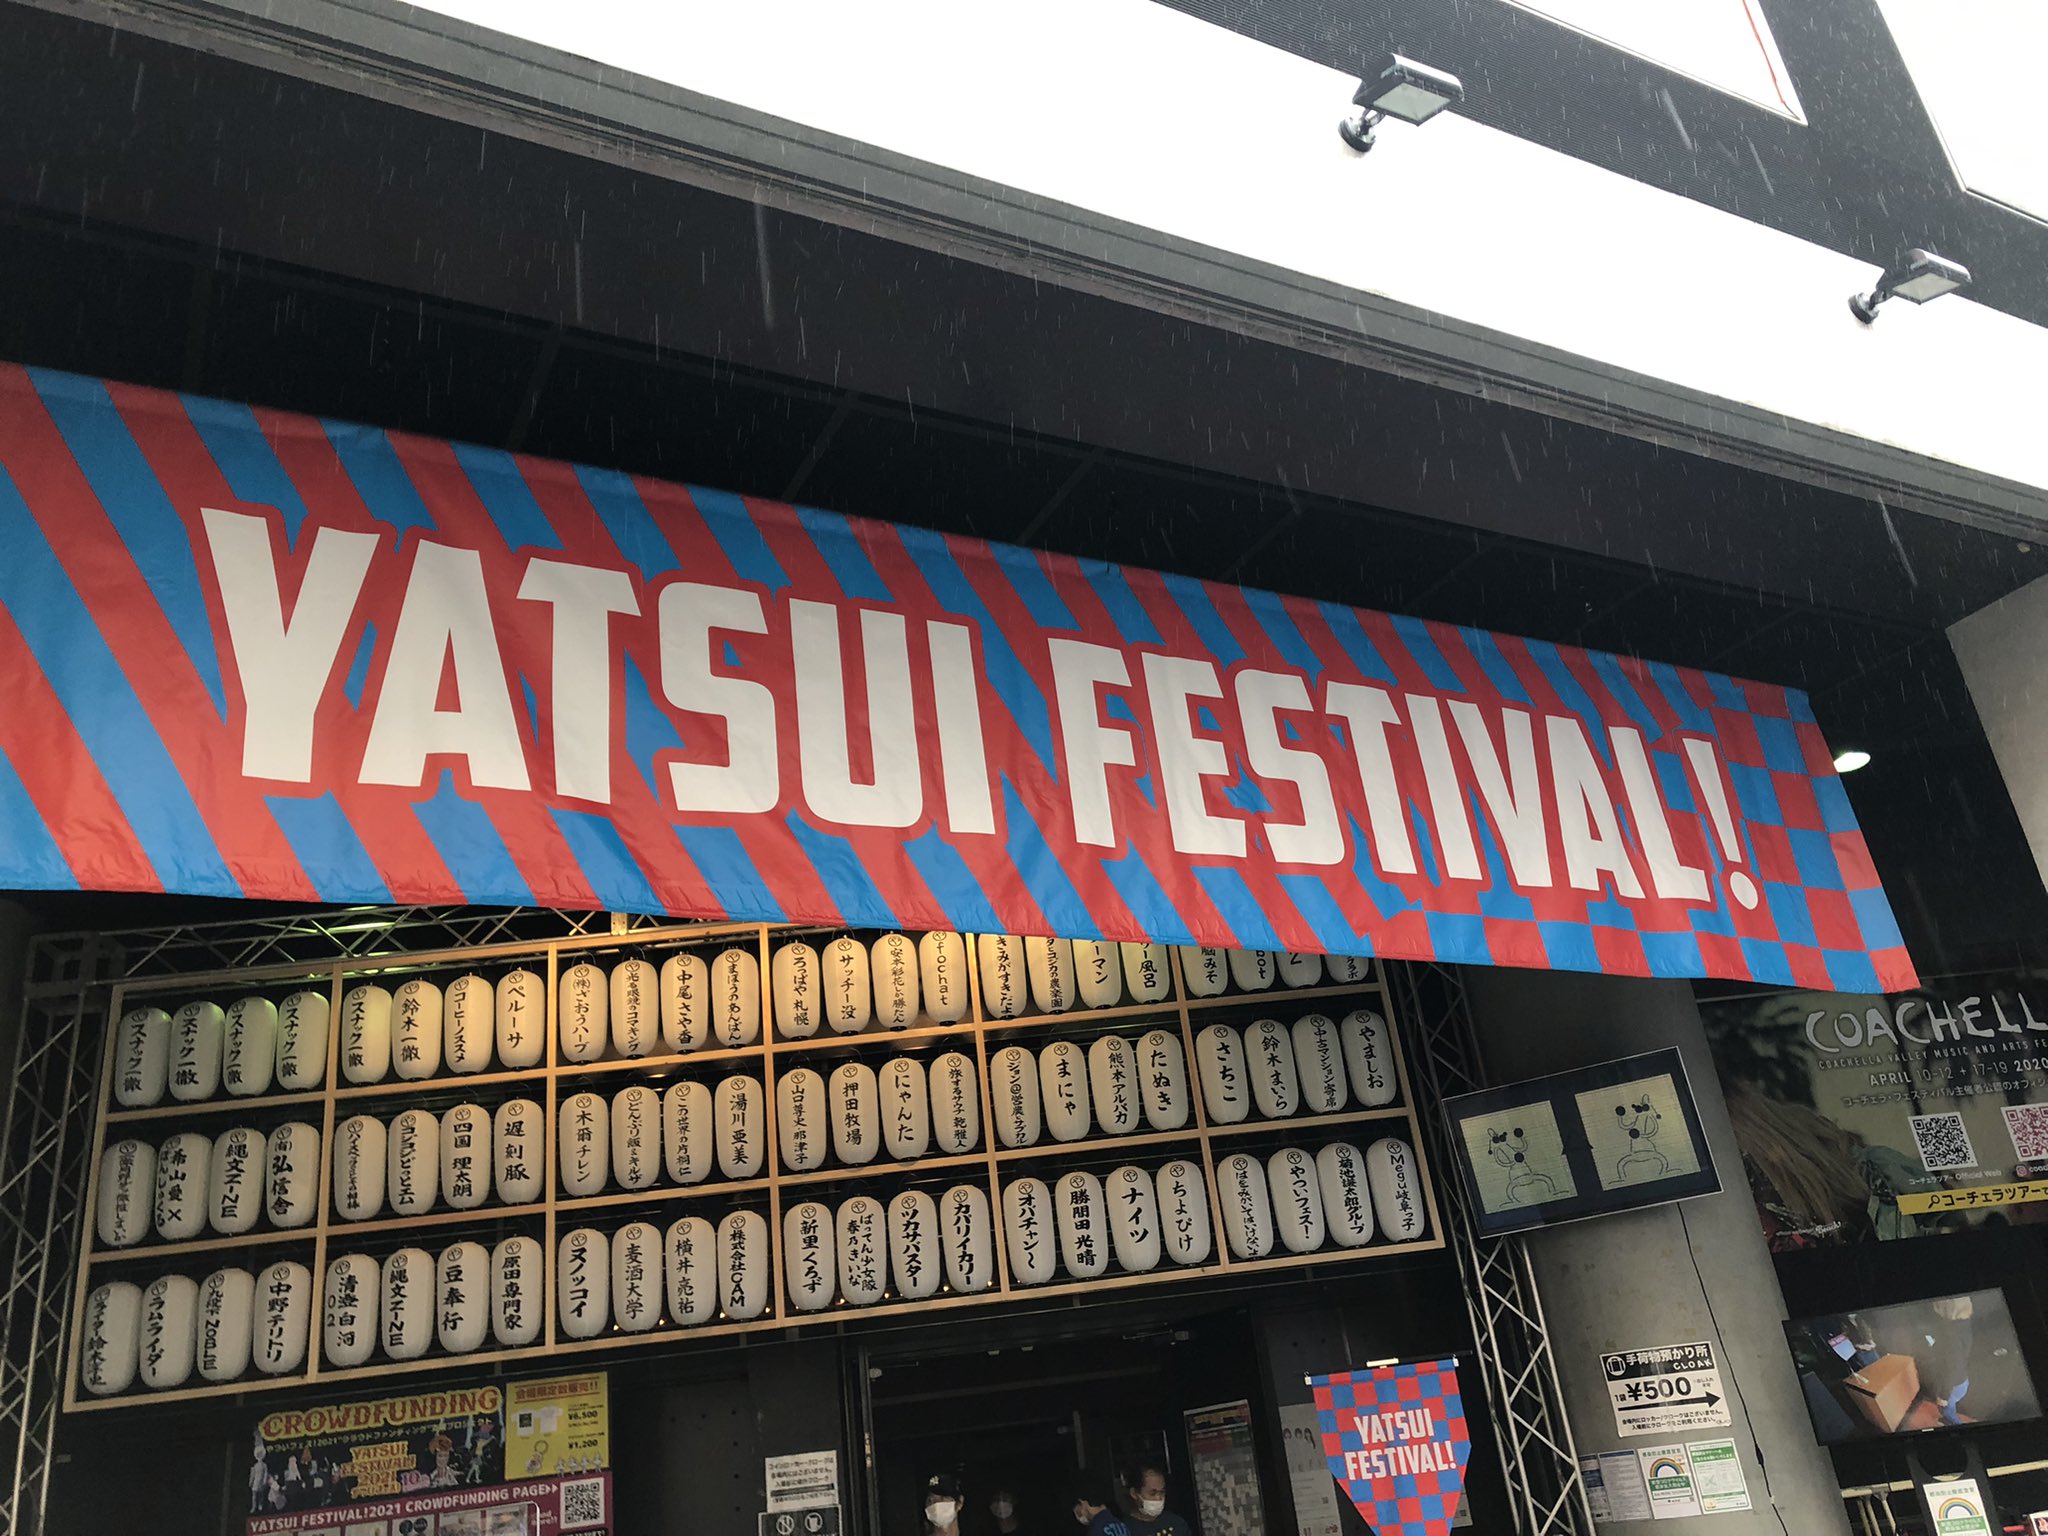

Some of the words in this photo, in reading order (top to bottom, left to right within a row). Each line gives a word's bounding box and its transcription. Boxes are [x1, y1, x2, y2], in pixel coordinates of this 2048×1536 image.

[200, 507, 996, 835] YATSUI
[1047, 637, 1758, 911] FESTIVAL!
[454, 992, 466, 1063] コーヒーノススメ
[507, 986, 526, 1048] ペルーサ
[1151, 1050, 1172, 1111] たぬき
[1216, 1043, 1237, 1102] さちこ
[1261, 1036, 1287, 1110] 鈴木まいら
[1359, 1026, 1384, 1089] やましお
[1819, 1055, 1881, 1069] COACHELLA
[1888, 1051, 1928, 1065] VALLEY
[1934, 1046, 1968, 1058] MUSIC
[1976, 1043, 1995, 1054] AND
[2003, 1040, 2029, 1052] ARTS
[1869, 1071, 1912, 1086] APRIL
[1917, 1066, 1952, 1081] 10-12
[1972, 1062, 2008, 1075] 17-19
[843, 1082, 862, 1145] 押田牧場
[895, 1075, 914, 1142] にゃんた
[1056, 1059, 1077, 1116] まにゃ
[729, 1094, 748, 1165] 湯川亜美
[1121, 1188, 1149, 1243] ナイツ
[729, 1229, 746, 1307] 株式会社CAM
[860, 1214, 878, 1292] ばってん少女隊
[901, 1208, 922, 1287] ツカサバスター
[442, 1265, 465, 1331] 豆奉行
[501, 1256, 522, 1330] 原田専門家
[625, 1243, 644, 1319] 麦酒大学
[1626, 1345, 1708, 1365] 手荷物預かり所
[1673, 1359, 1712, 1370] CLOAK
[261, 1388, 499, 1438] CROWDFUNDING
[1625, 1376, 1692, 1402] ¥500
[1353, 1407, 1434, 1445] YATSUI
[1345, 1440, 1457, 1481] FESTIVAL!
[251, 1515, 299, 1534] YATSUI
[301, 1501, 401, 1528] FESTIVAL!2021
[405, 1488, 509, 1514] CROWDFUNDING
[513, 1482, 547, 1498] PAGE
